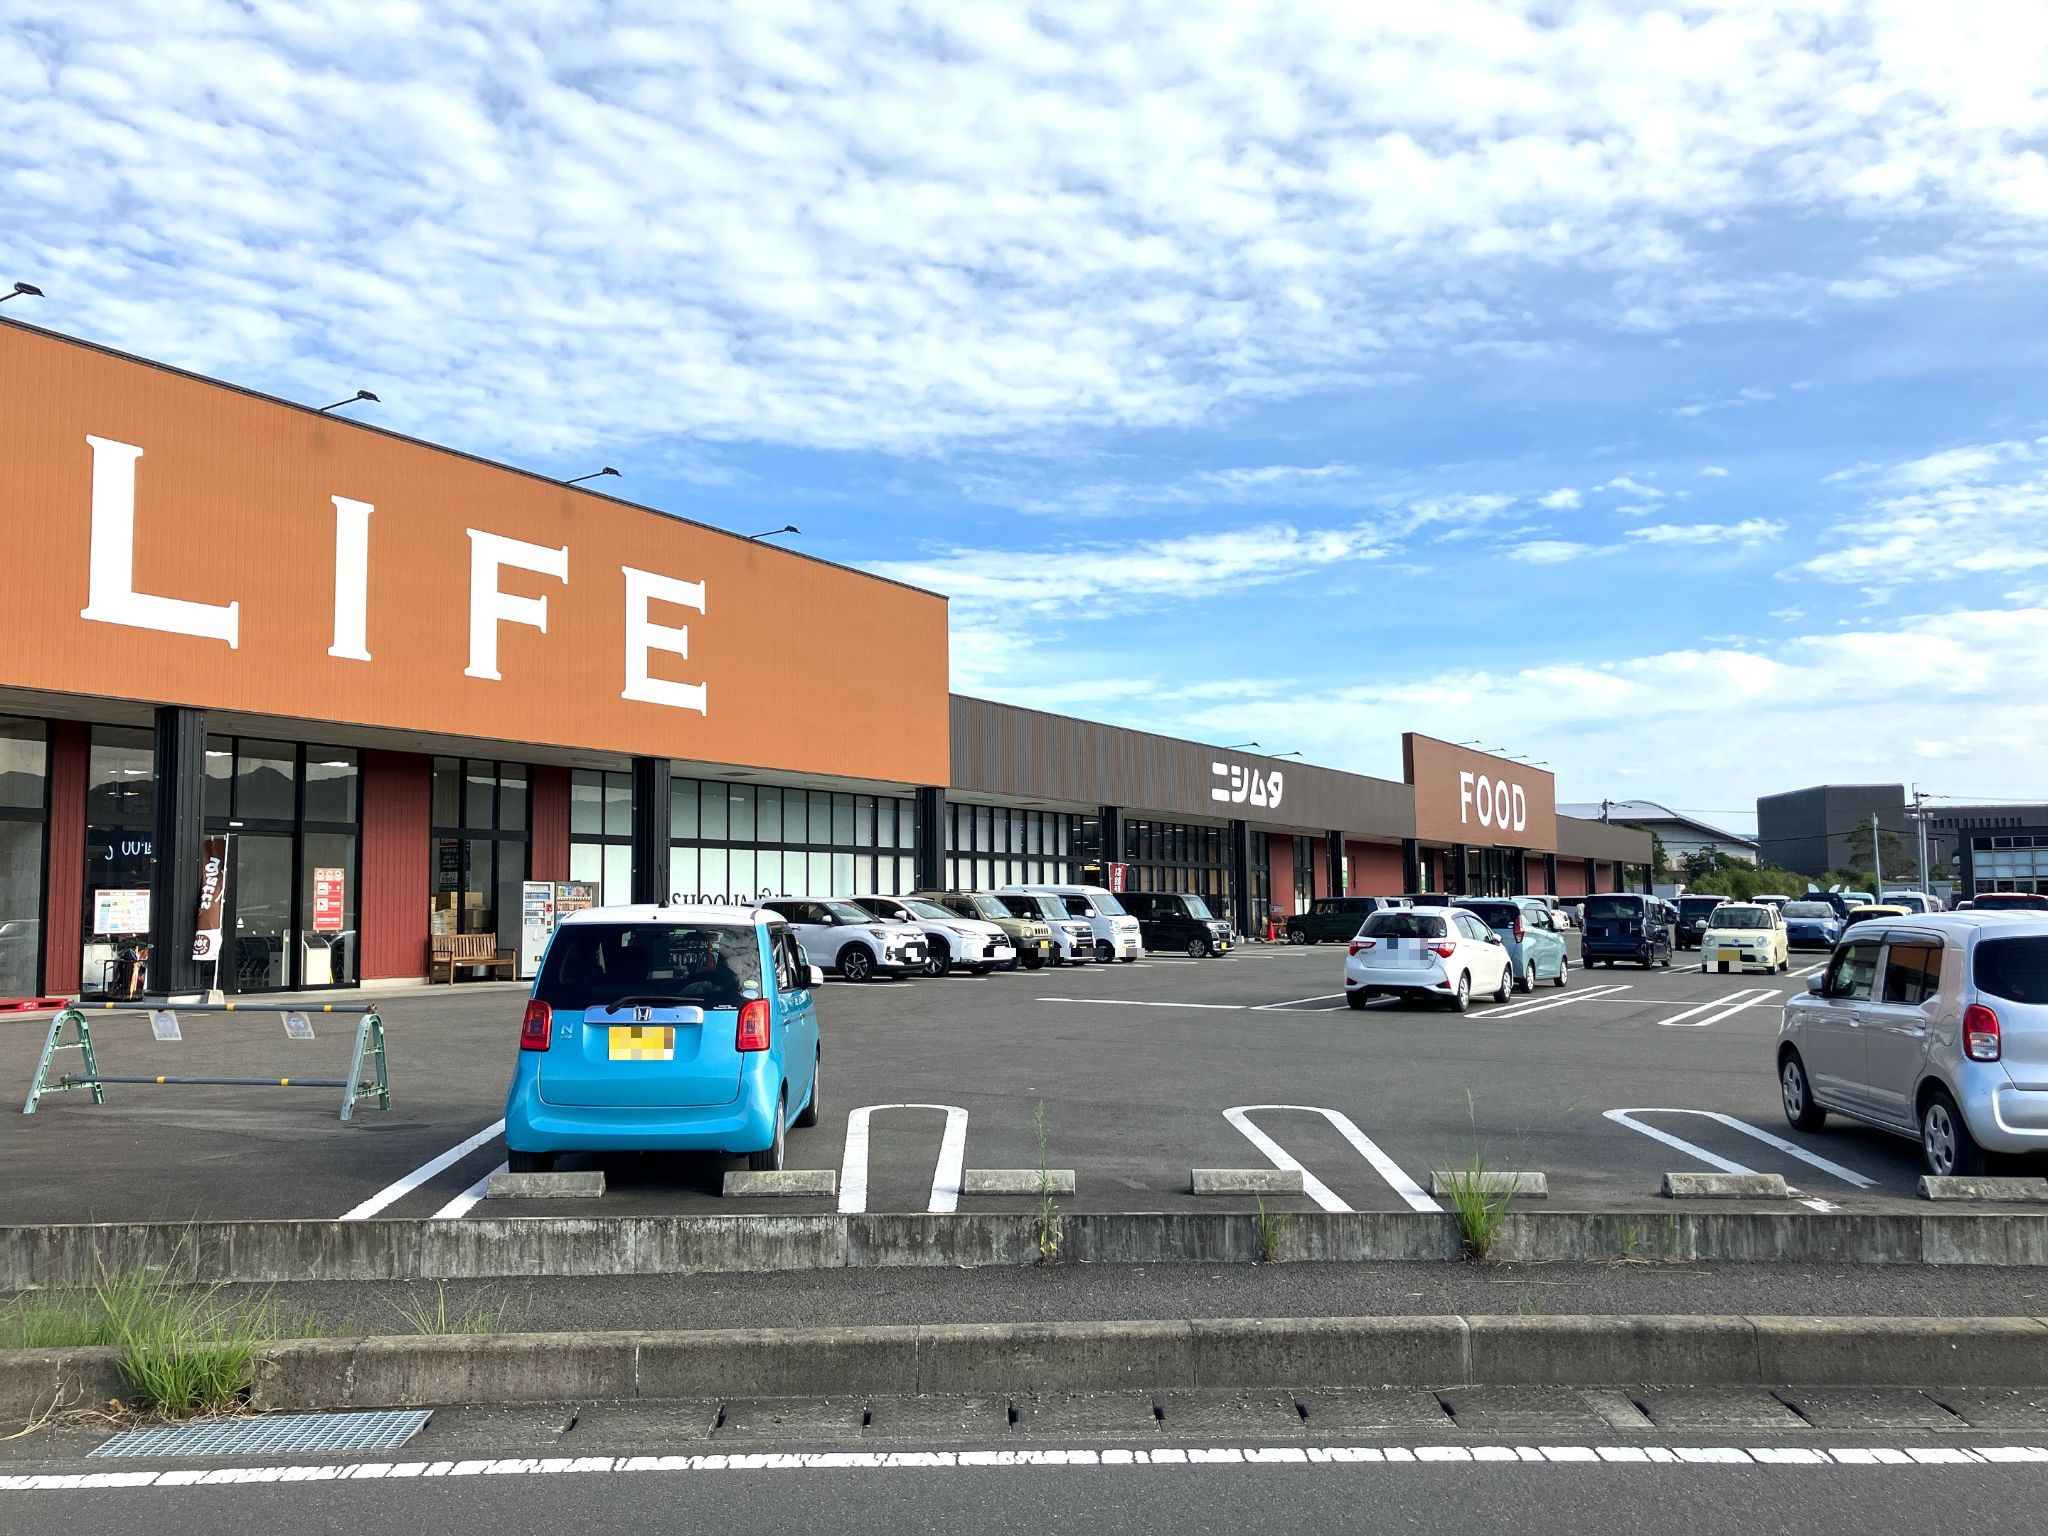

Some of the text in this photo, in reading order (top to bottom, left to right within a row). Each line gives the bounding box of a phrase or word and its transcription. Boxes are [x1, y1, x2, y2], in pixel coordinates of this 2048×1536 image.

[81, 434, 708, 717] LIFE
[1212, 761, 1283, 809] ニシムタ
[1459, 770, 1526, 832] FOOD
